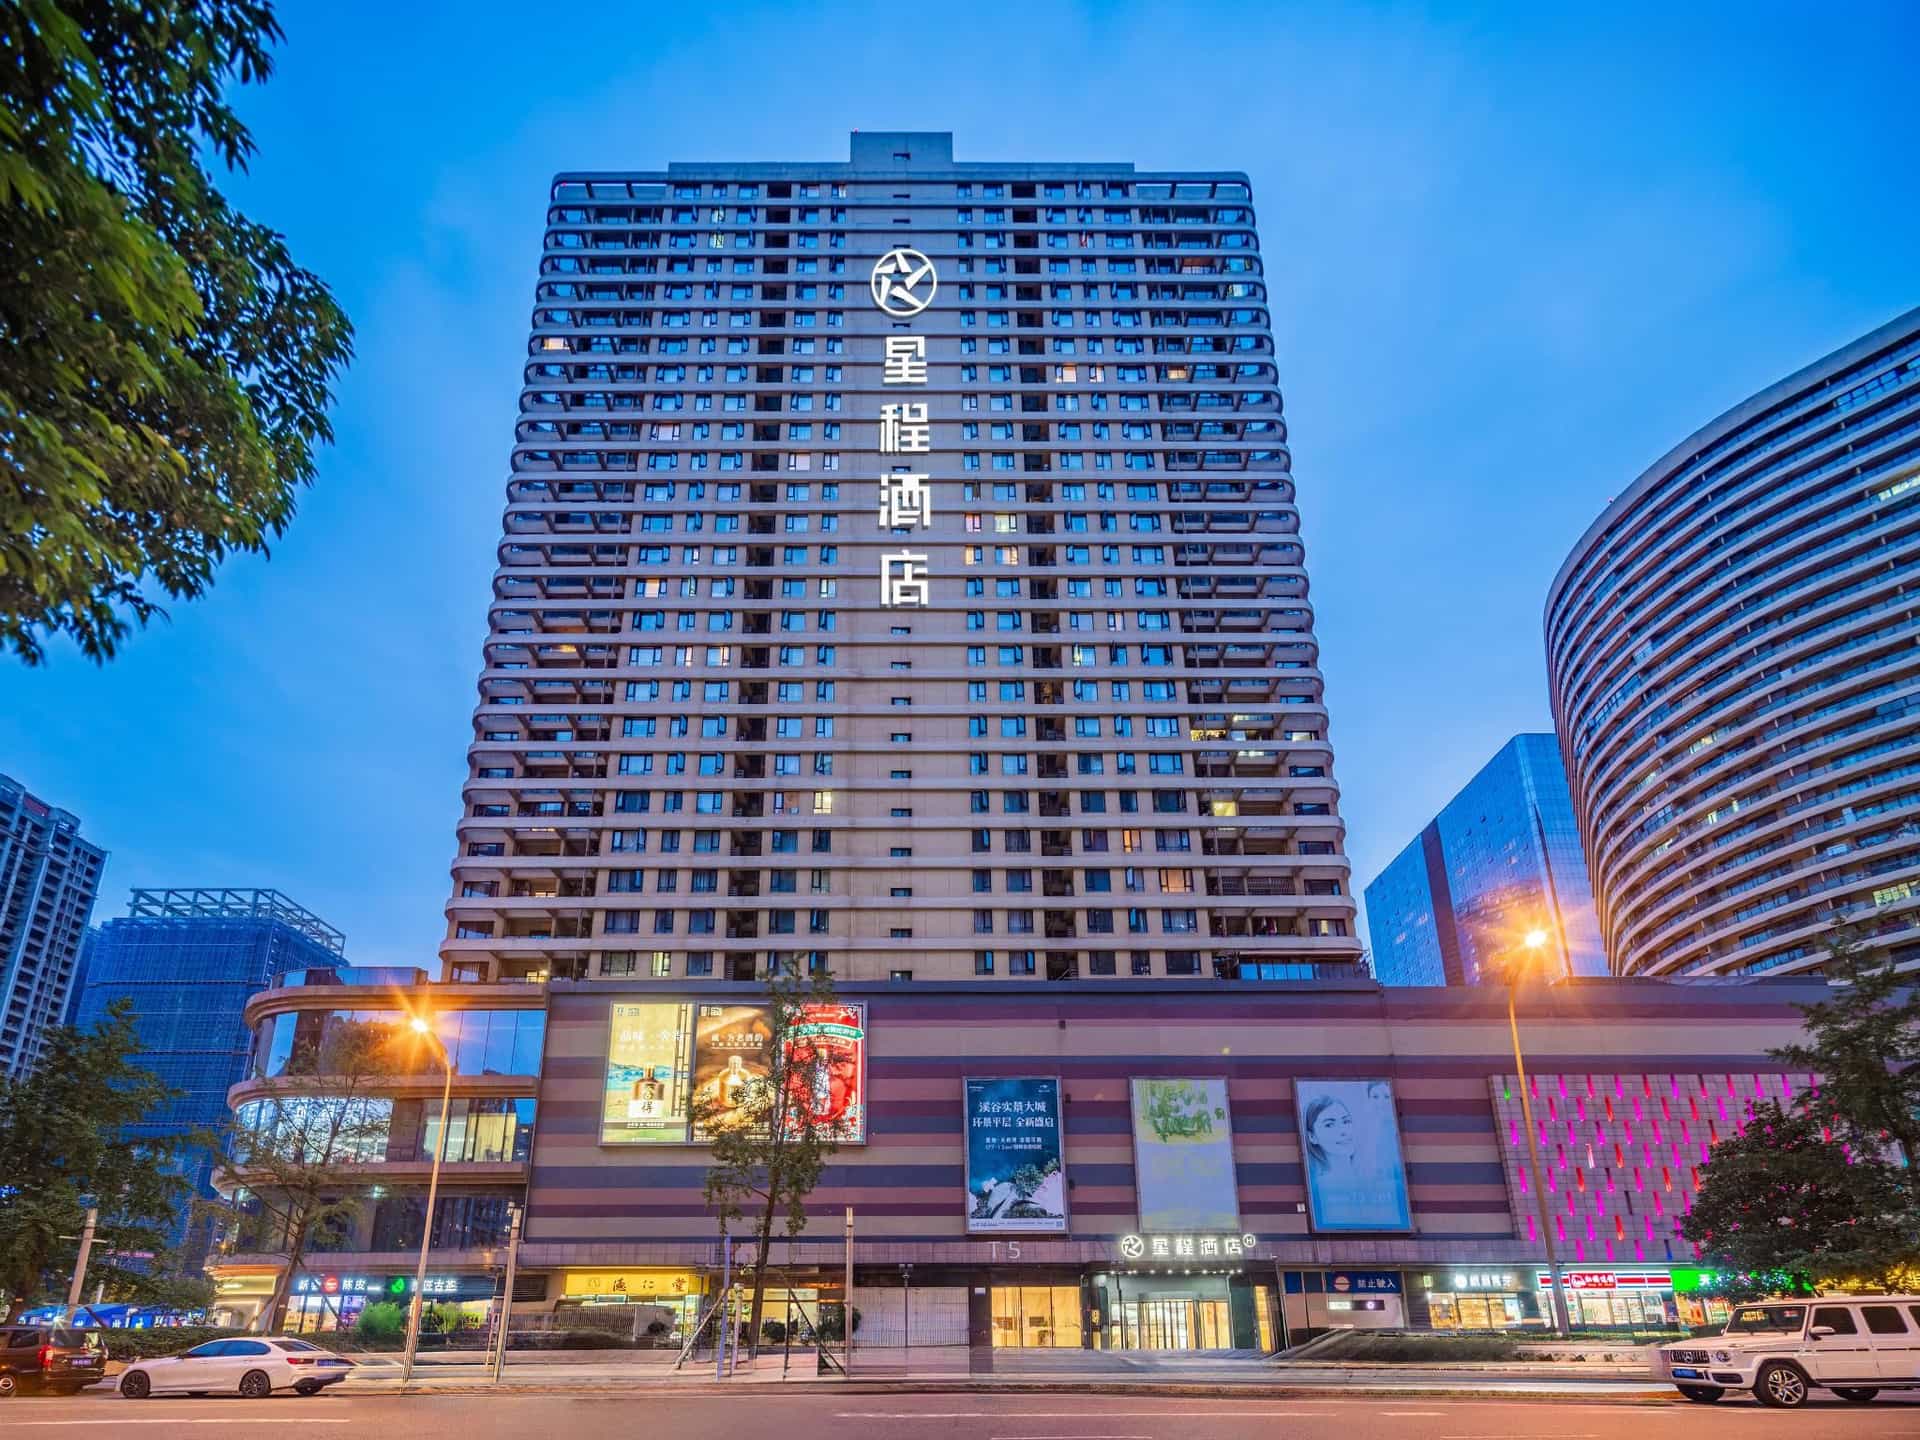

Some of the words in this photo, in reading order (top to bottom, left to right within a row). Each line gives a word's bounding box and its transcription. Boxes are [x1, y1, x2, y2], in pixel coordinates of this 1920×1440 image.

[879, 335, 931, 607] 星程酒店
[1151, 1237, 1242, 1256] 星程酒店
